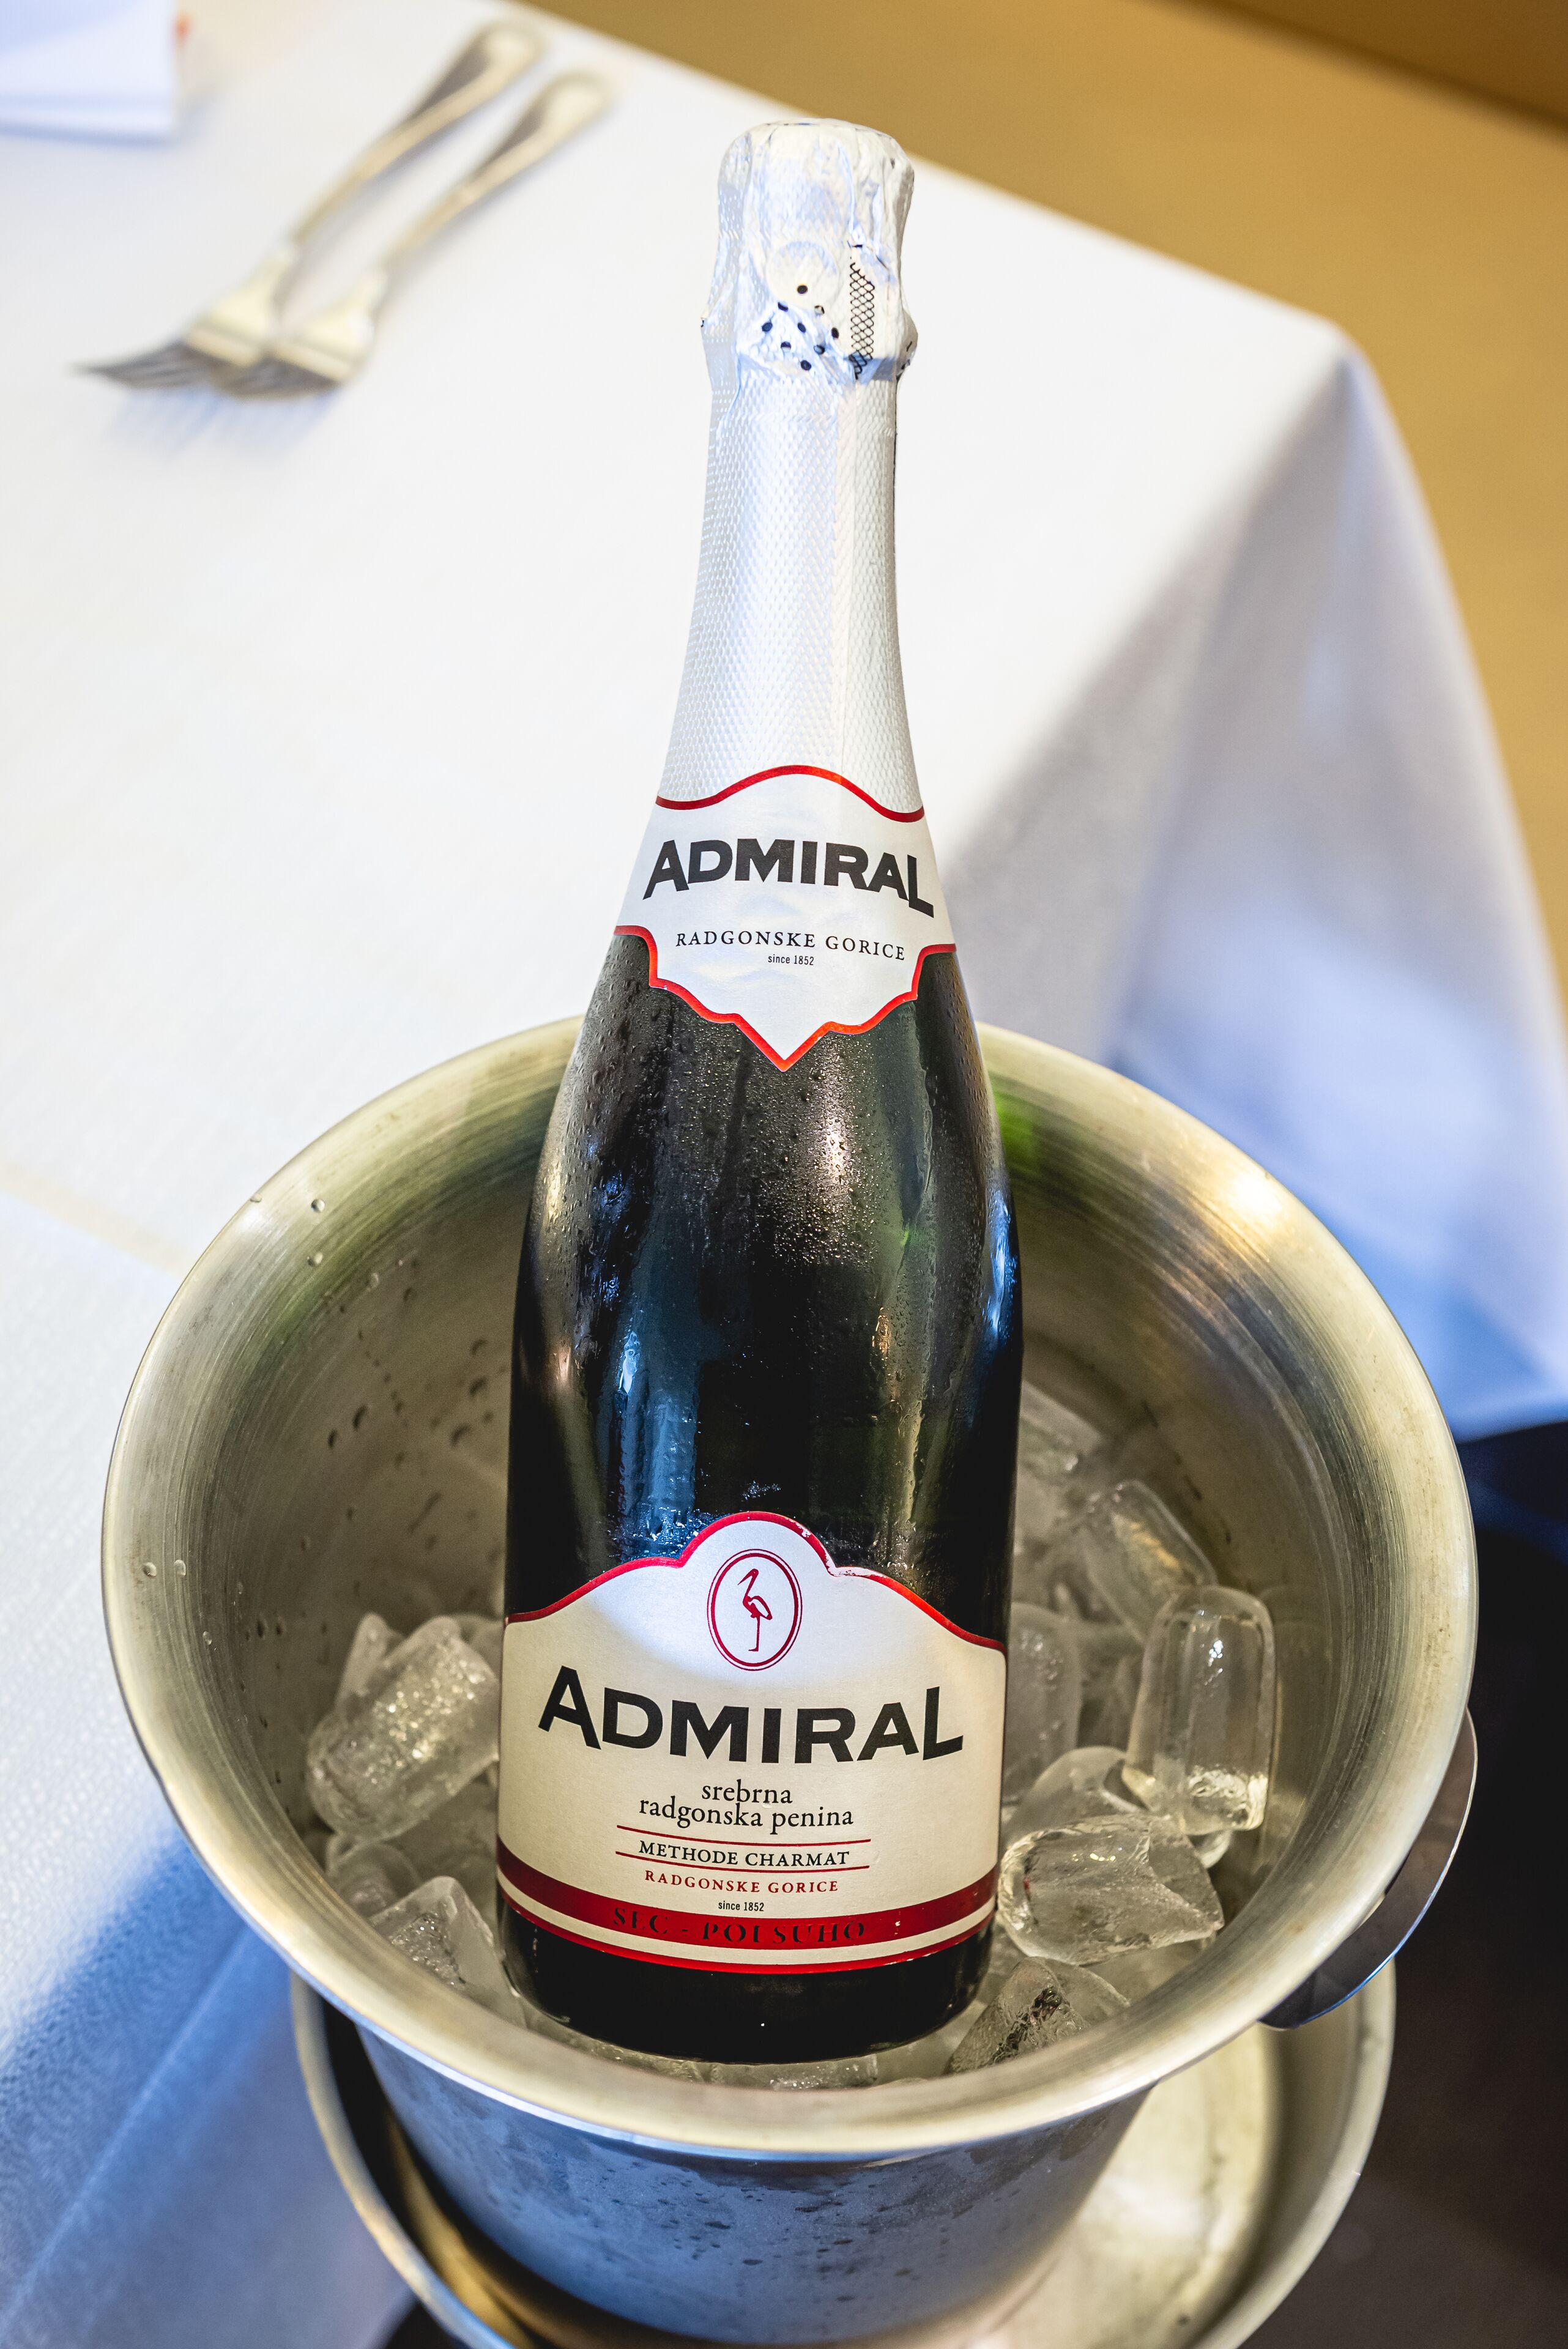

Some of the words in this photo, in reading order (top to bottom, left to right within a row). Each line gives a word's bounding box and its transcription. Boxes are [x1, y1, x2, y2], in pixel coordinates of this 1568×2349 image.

[642, 838, 934, 918] ADMIRAL
[675, 930, 816, 948] RADGONSKE
[825, 935, 905, 961] GORICE
[768, 954, 790, 965] since
[793, 955, 814, 966] 1852
[538, 1665, 964, 1764] ADMIRAL
[702, 1779, 793, 1805] srebrna
[639, 1795, 763, 1829] radgonska
[770, 1806, 853, 1835] penina
[639, 1840, 738, 1865] METHODE
[745, 1851, 850, 1867] CHARMAT
[645, 1870, 760, 1893] RADGONSKE
[768, 1880, 838, 1894] GORICE
[718, 1901, 740, 1911] since
[743, 1902, 765, 1912] 1852
